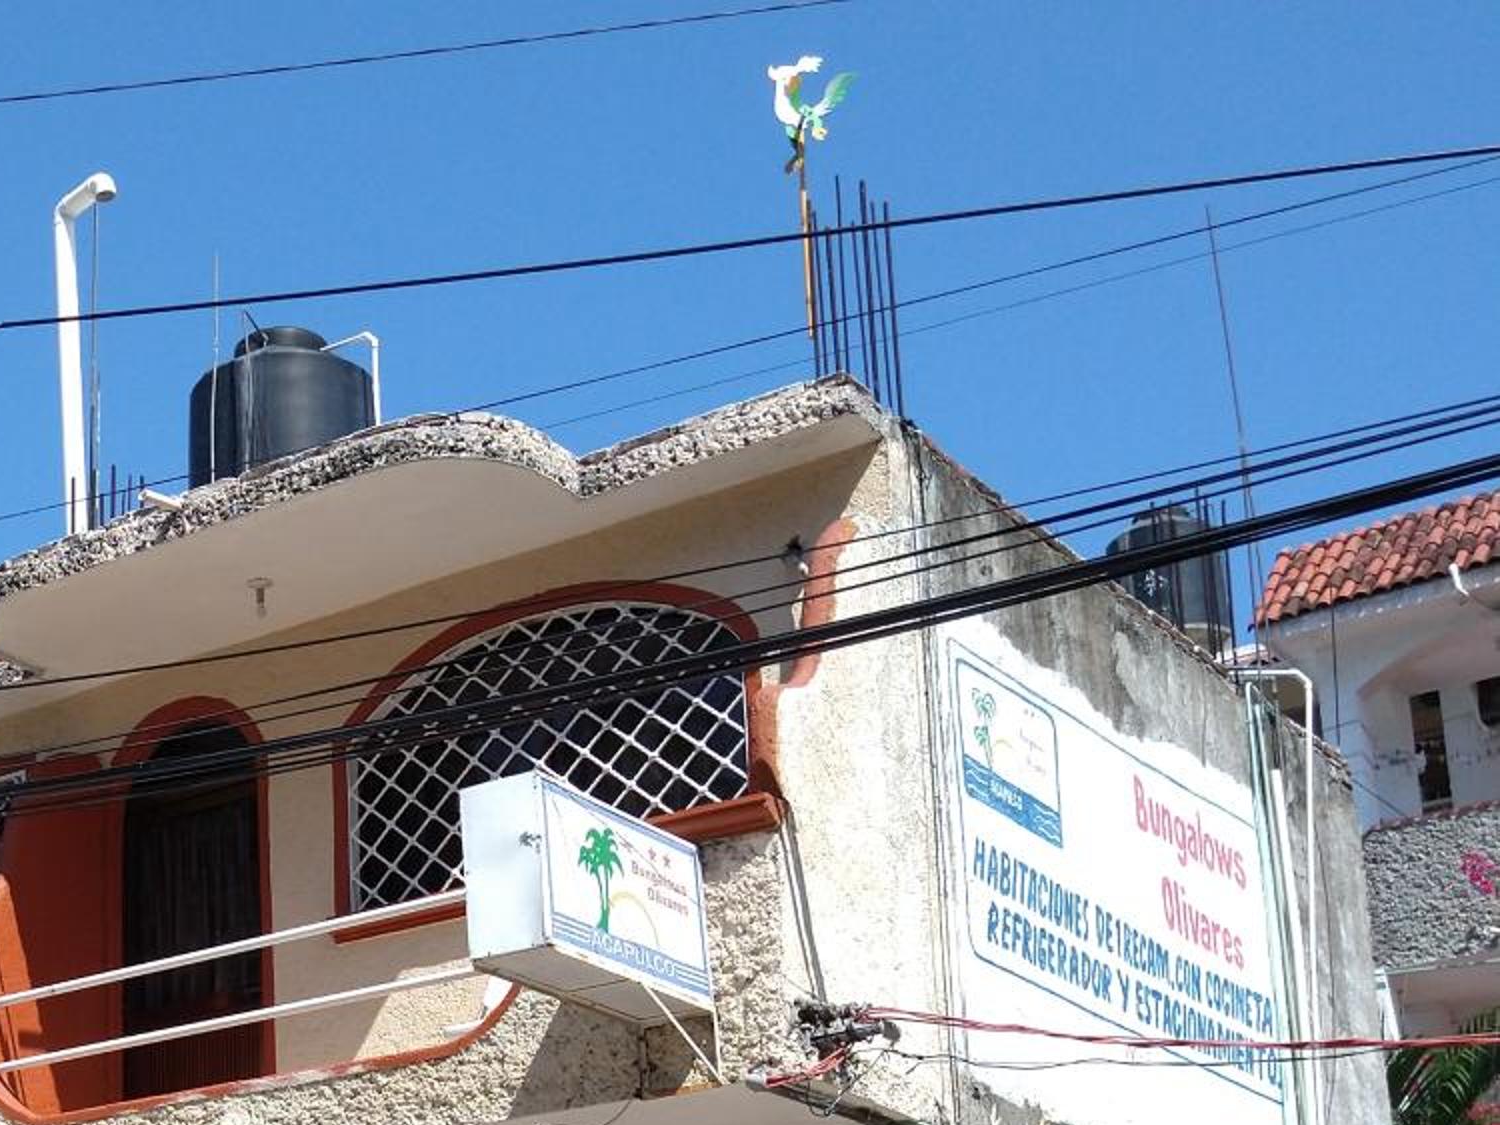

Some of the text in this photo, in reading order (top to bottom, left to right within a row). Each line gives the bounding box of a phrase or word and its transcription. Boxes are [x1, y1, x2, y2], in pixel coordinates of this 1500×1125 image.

[1134, 774, 1247, 890] Bungalows
[590, 926, 678, 977] ACAPULCO
[974, 837, 1089, 941] HABITACIONES
[1095, 904, 1113, 953] DE
[1175, 955, 1202, 1003] CON
[1205, 971, 1273, 1037] COCINETA
[987, 901, 1112, 1003] REFRIGERADOR
[1117, 968, 1129, 1013] Y
[1162, 876, 1244, 971] Olivares
